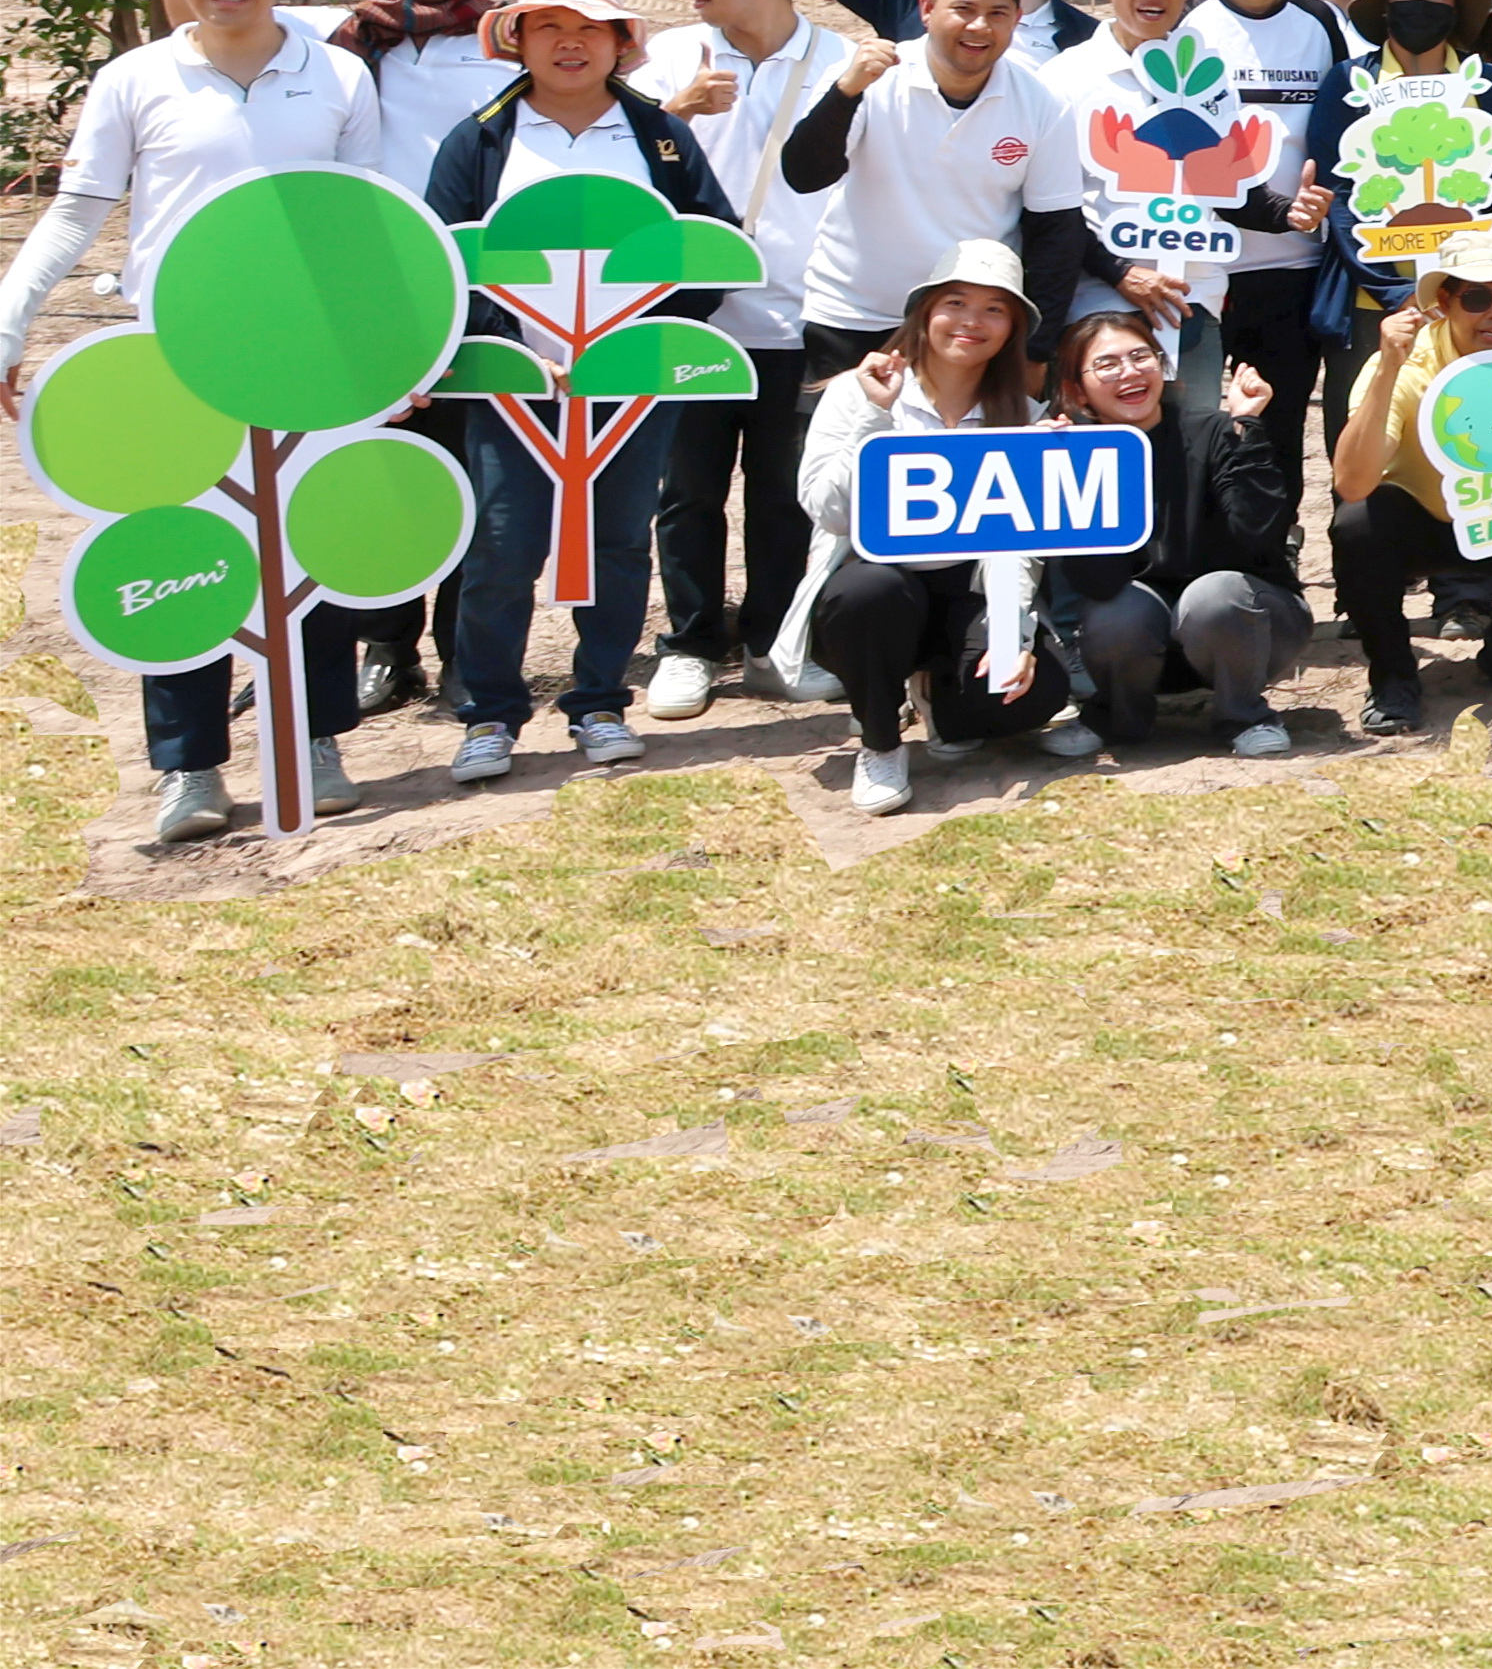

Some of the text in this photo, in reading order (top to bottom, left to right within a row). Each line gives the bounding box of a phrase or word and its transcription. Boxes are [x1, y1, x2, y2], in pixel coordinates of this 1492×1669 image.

[1260, 69, 1319, 83] THOUSAND
[1369, 80, 1446, 108] WE NEED
[1147, 197, 1201, 224] Go
[1110, 221, 1234, 255] Green
[1379, 232, 1426, 252] MORE
[673, 357, 732, 385] Bam
[888, 447, 1118, 537] BAM
[116, 558, 230, 617] Bam
